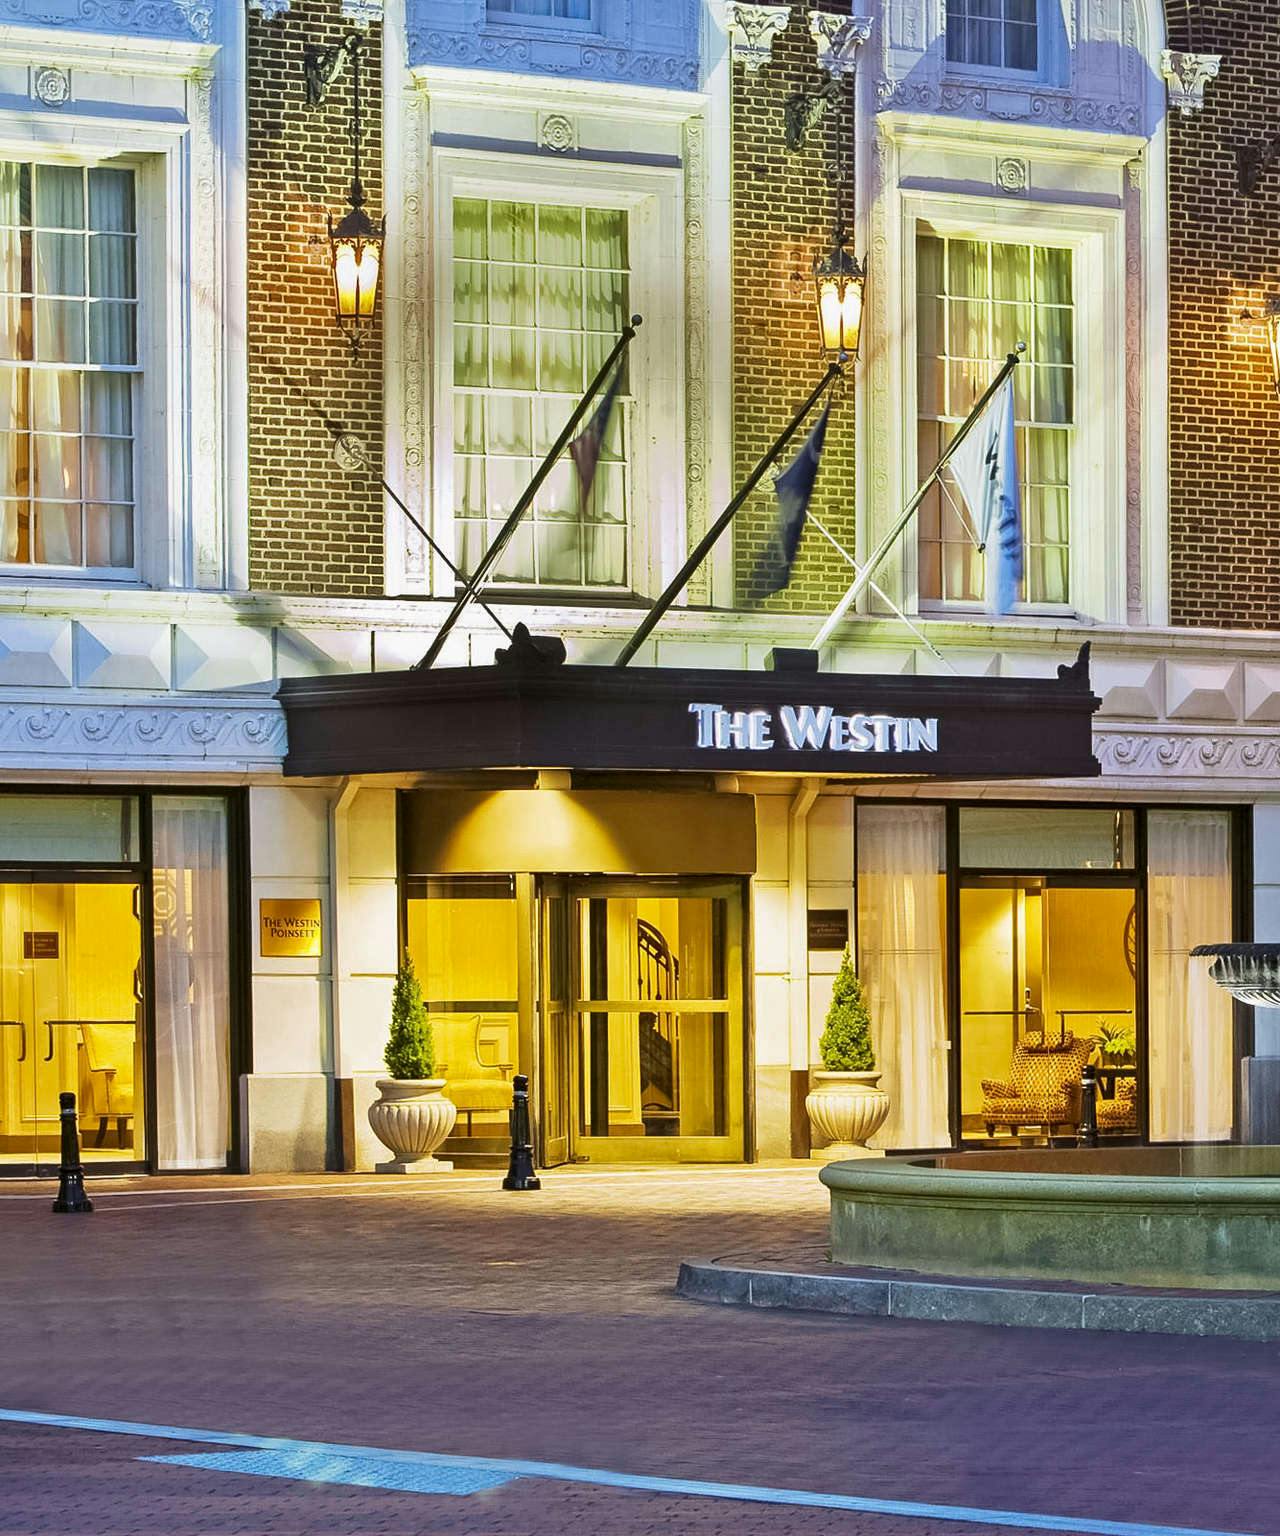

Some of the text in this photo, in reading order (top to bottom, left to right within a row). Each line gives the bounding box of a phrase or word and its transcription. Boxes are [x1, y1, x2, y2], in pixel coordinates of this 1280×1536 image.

[688, 703, 939, 752] THE WESTIN
[263, 917, 320, 928] THE WESTIN
[271, 928, 315, 938] POINSETT
